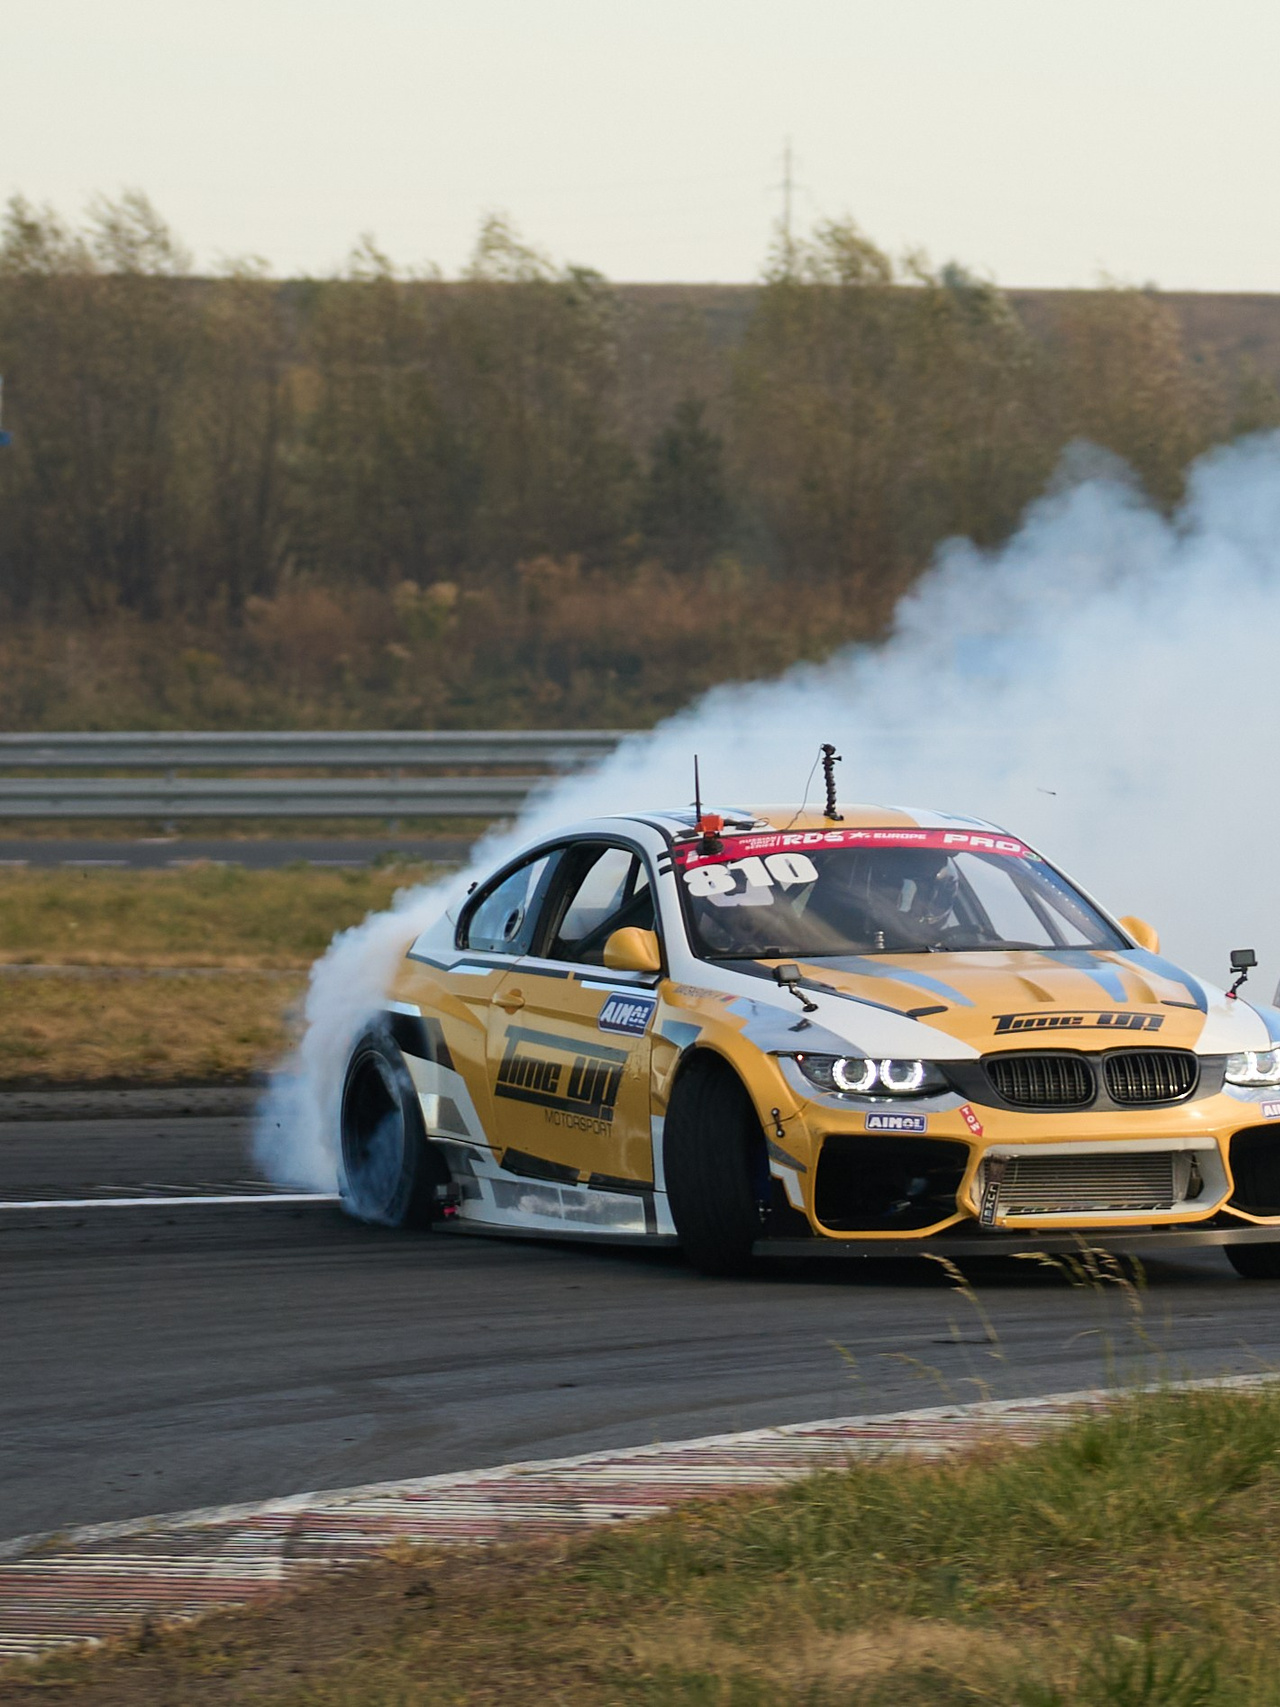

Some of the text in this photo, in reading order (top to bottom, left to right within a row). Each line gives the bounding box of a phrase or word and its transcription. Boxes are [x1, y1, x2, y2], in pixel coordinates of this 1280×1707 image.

[943, 833, 1021, 853] PRO
[682, 852, 819, 897] 810
[545, 1109, 613, 1138] MOTORSPORT
[960, 1106, 981, 1132] TOW
